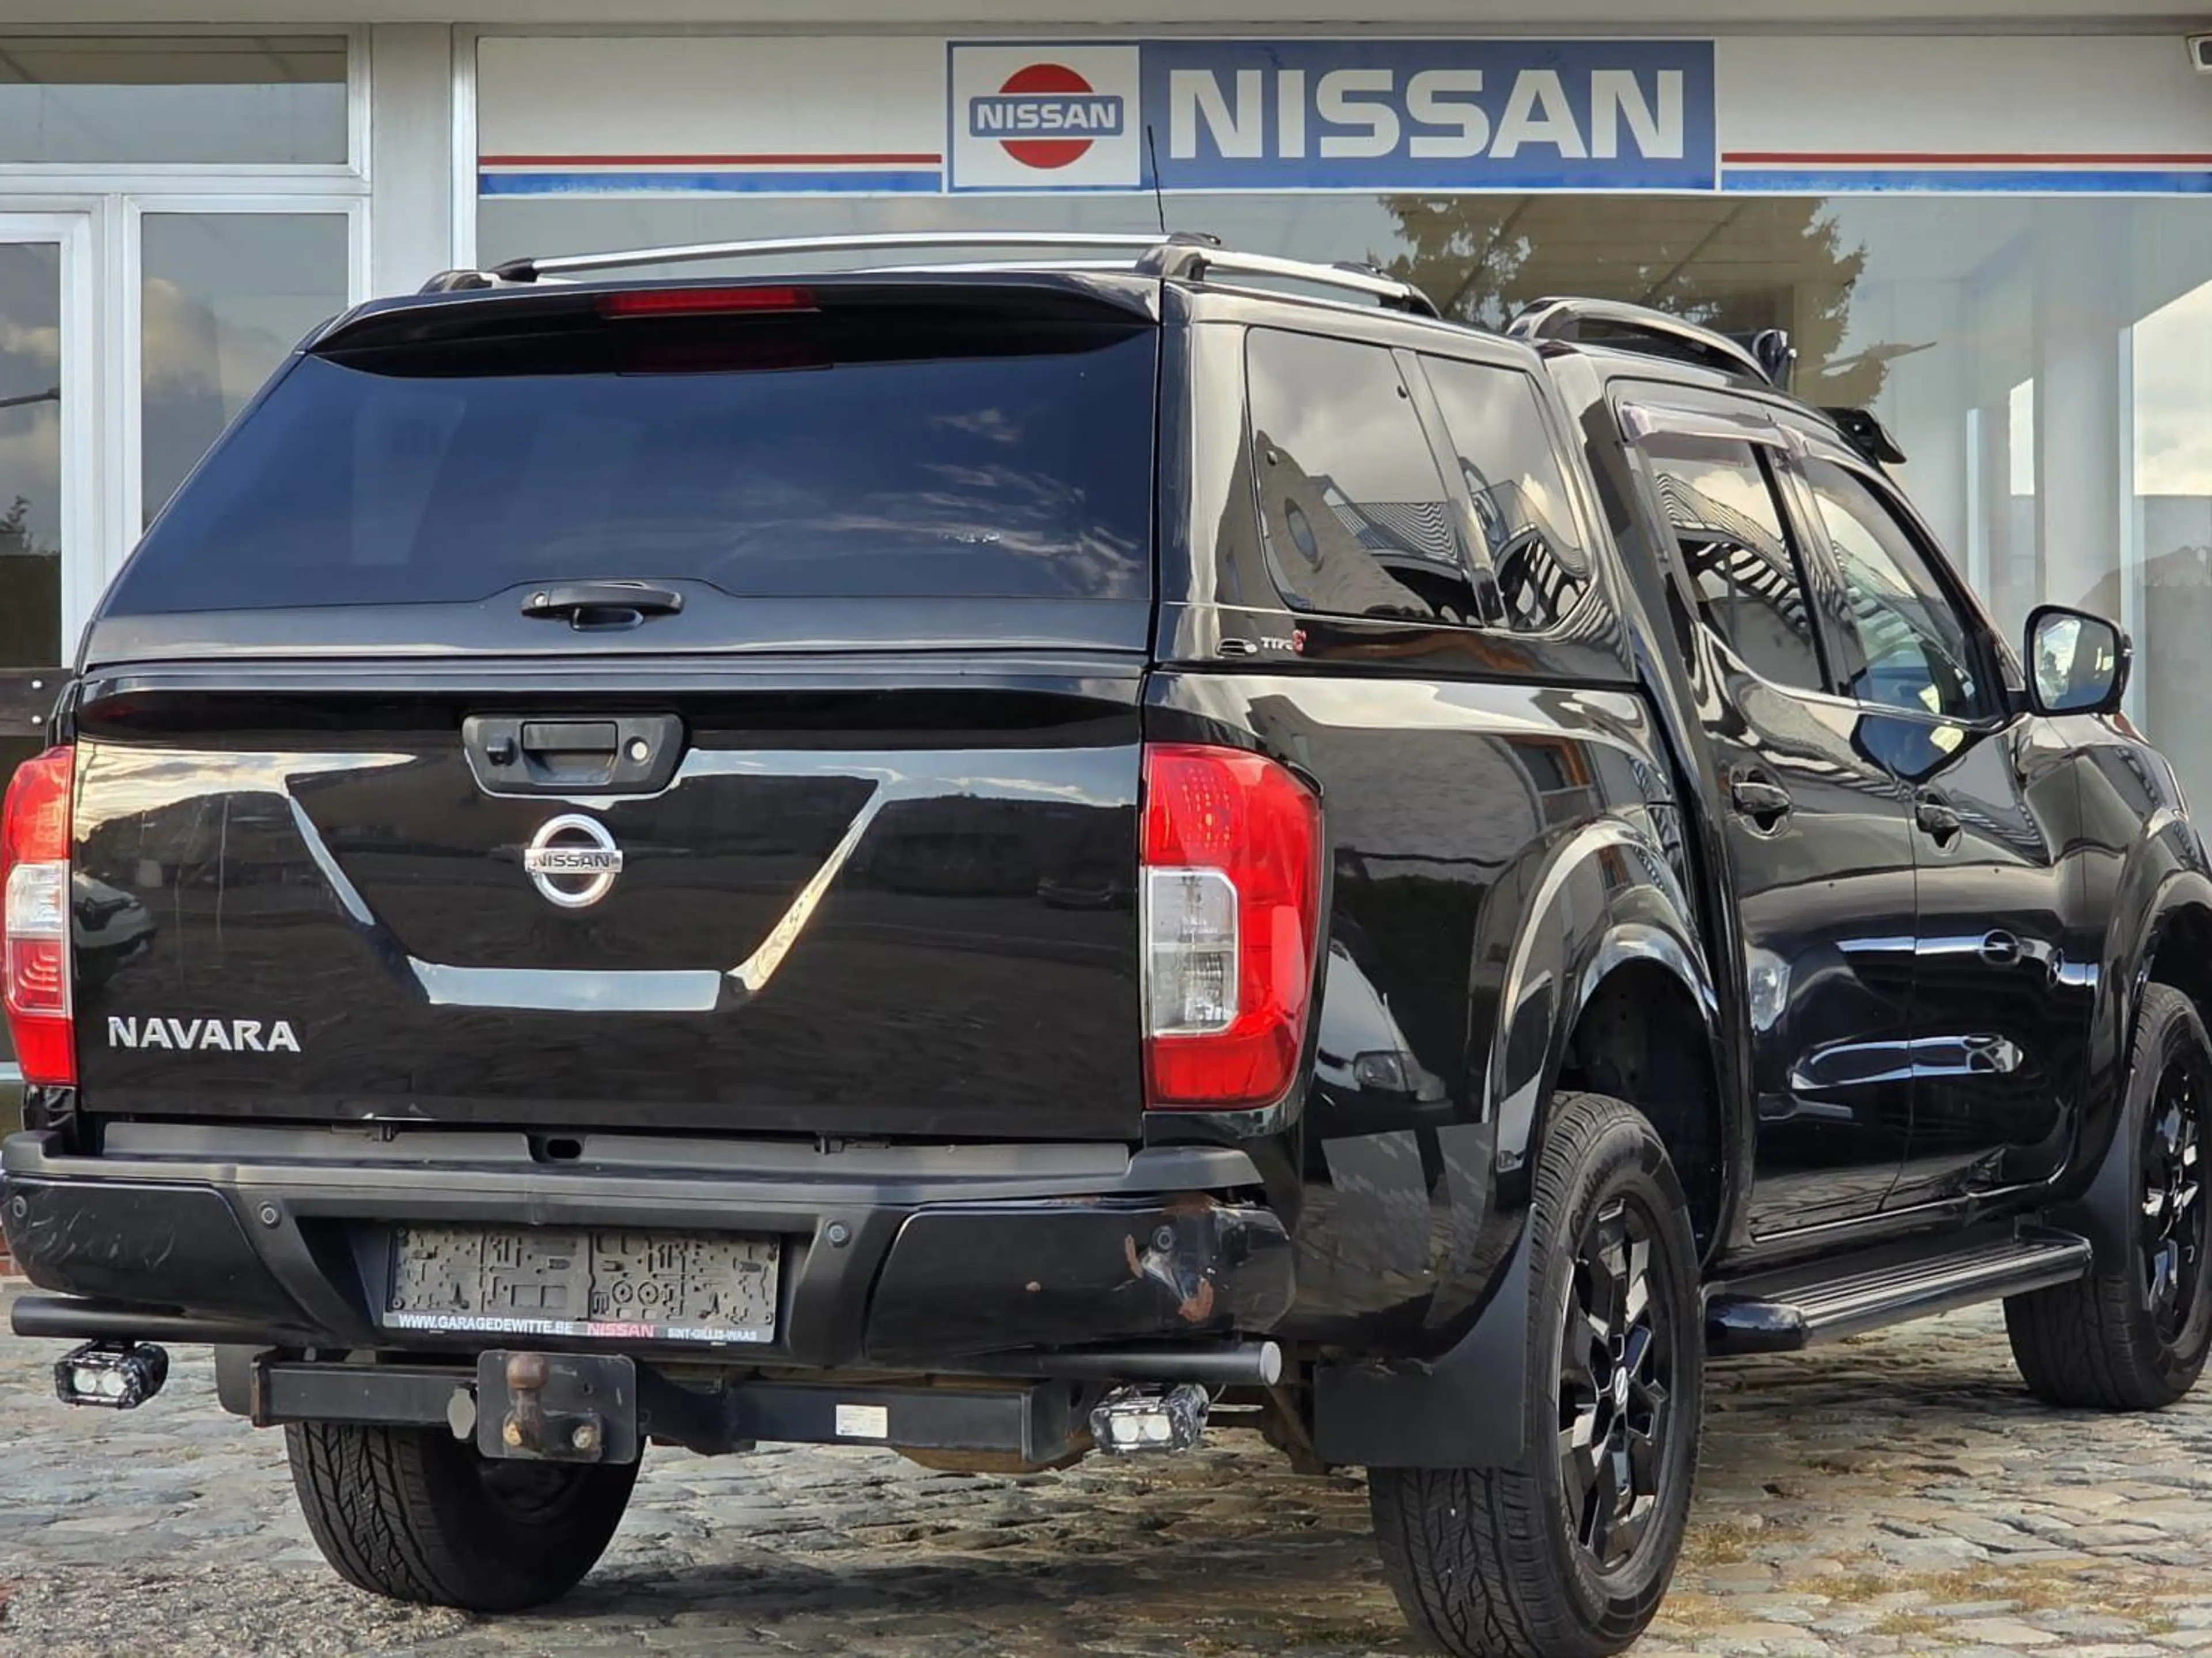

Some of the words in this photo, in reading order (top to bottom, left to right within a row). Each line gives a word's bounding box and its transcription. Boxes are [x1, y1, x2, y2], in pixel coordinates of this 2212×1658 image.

[976, 102, 1116, 130] NISSAN
[1169, 69, 1684, 159] NISSAN
[533, 854, 610, 868] NISSAN
[107, 1016, 301, 1053] NAVARA
[397, 1315, 574, 1334] WWW.GARAGEDEWITTE.BE
[586, 1322, 654, 1337] NISSAN
